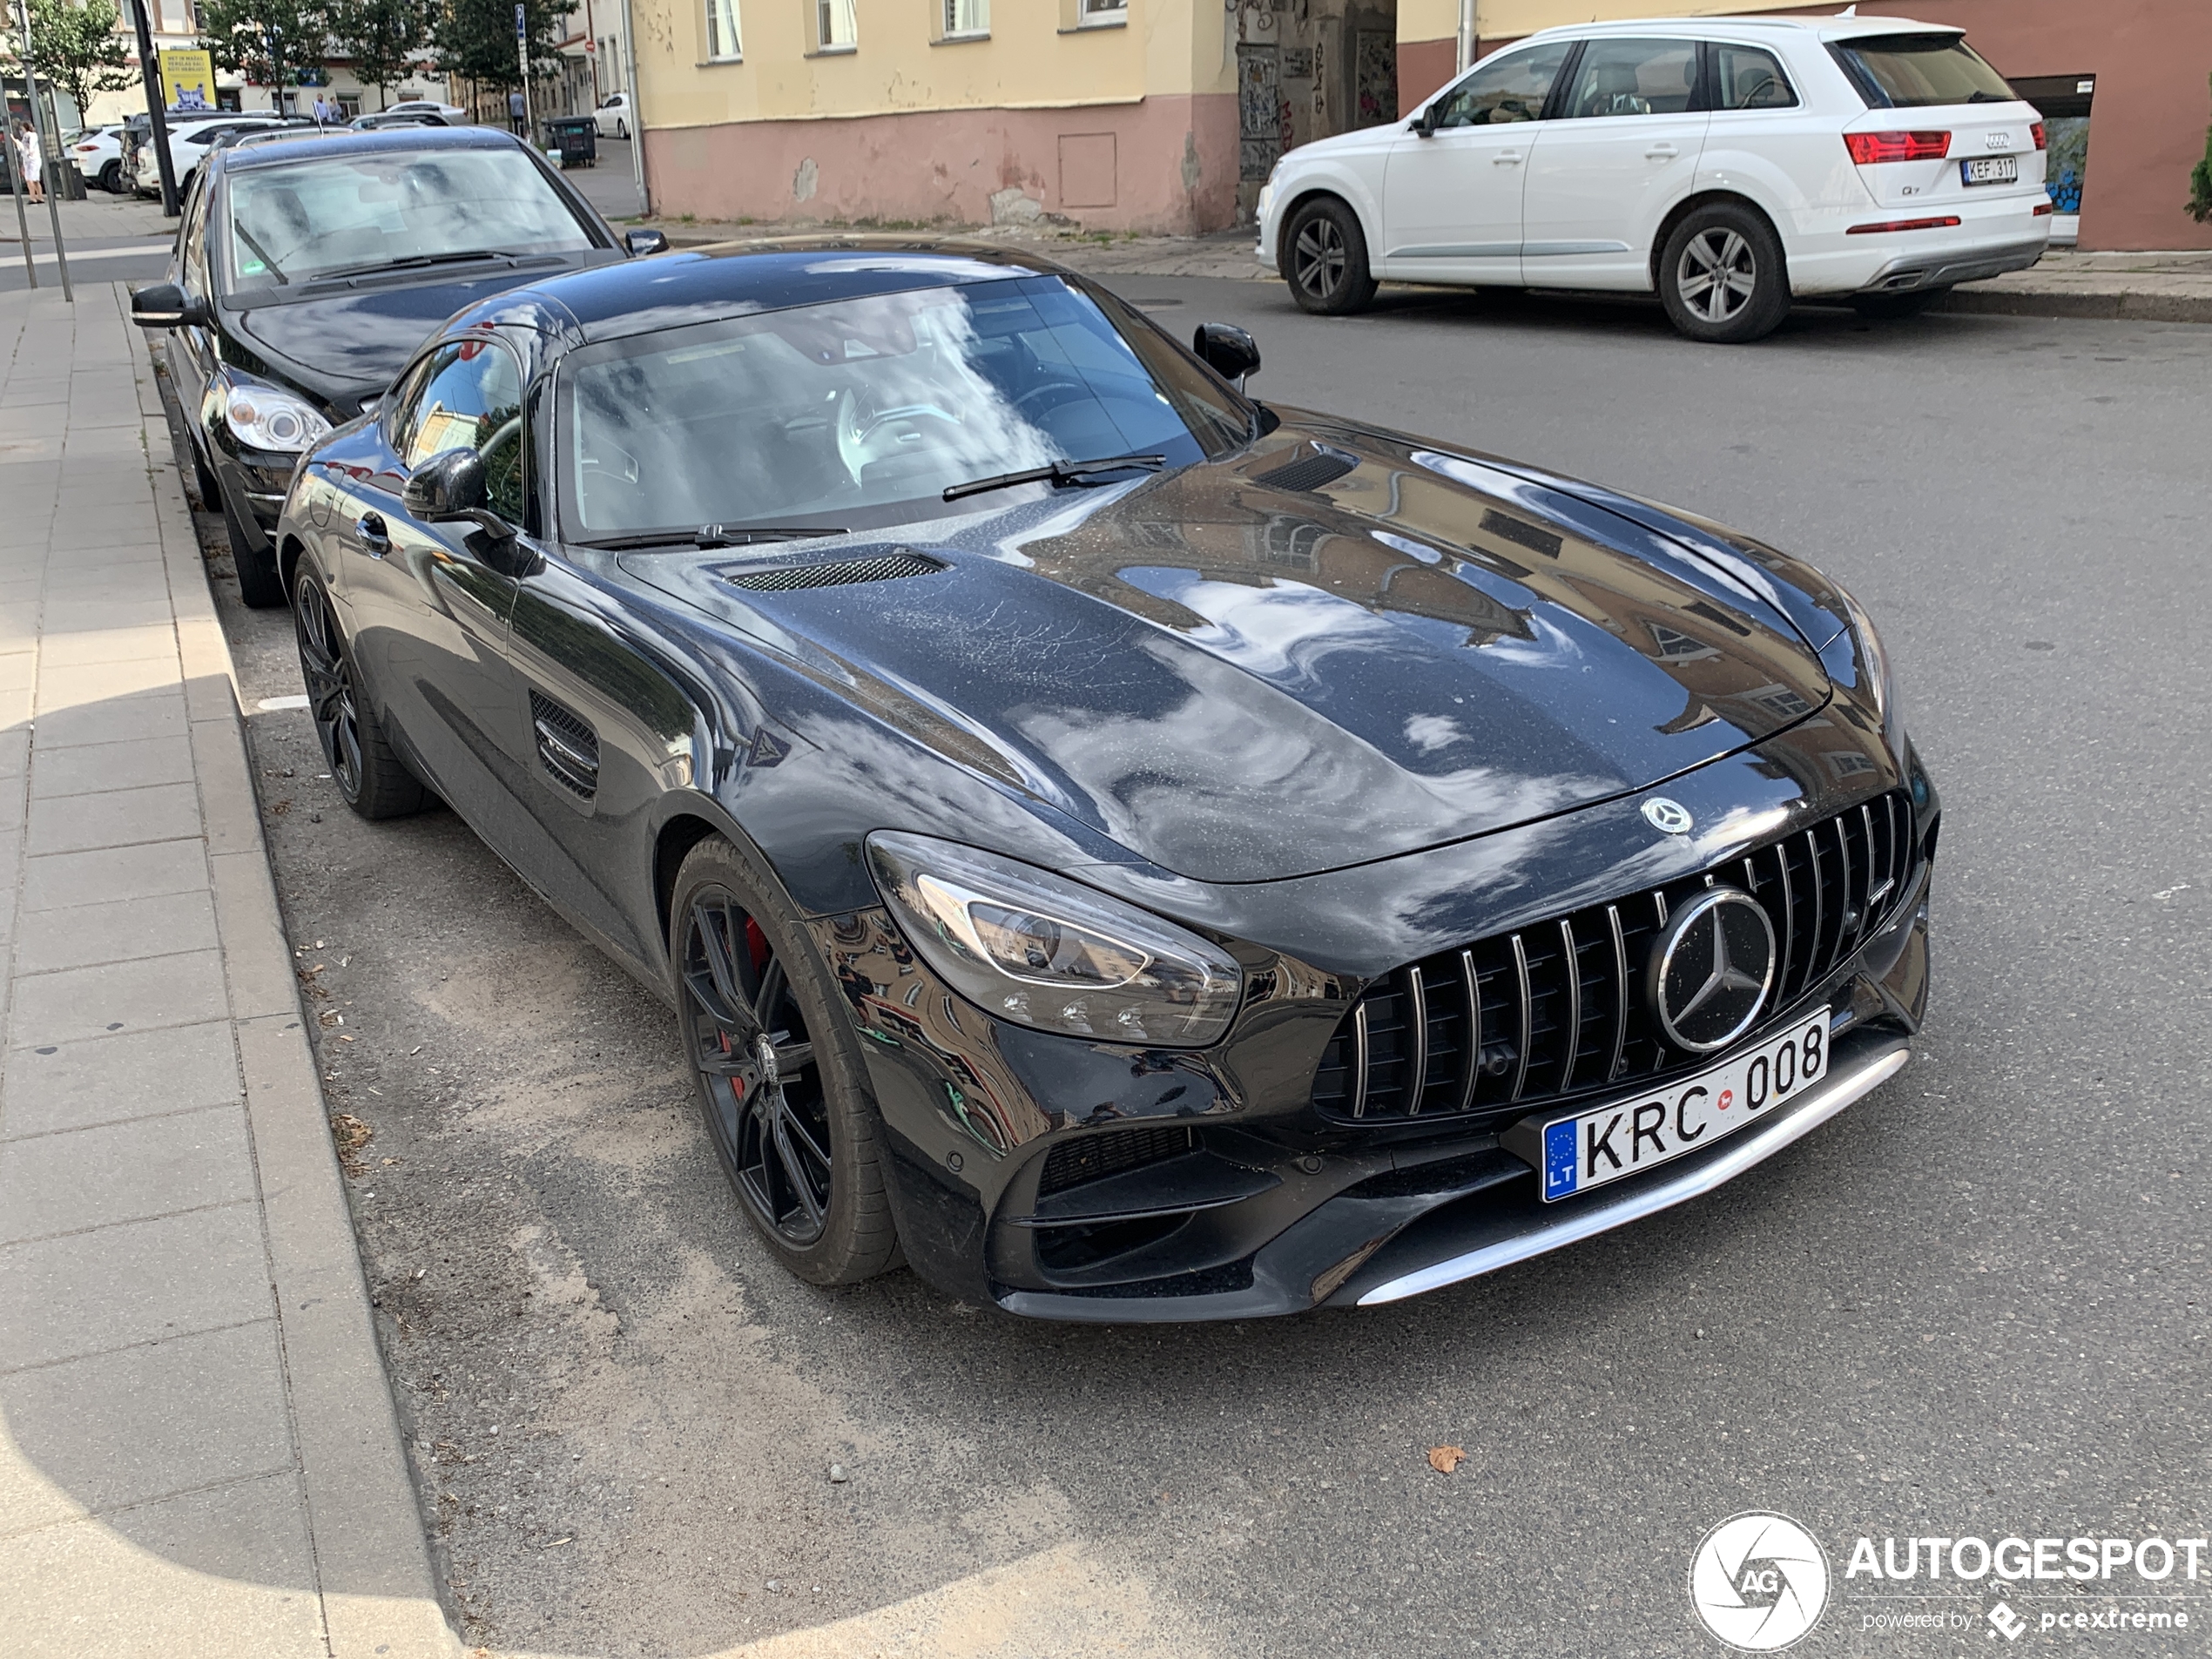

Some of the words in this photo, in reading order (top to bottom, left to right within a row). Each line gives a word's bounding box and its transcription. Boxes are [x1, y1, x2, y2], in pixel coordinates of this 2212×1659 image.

[1970, 161, 1990, 179] KEF
[1997, 159, 2013, 177] 317
[1588, 1086, 1708, 1178] KRC
[1747, 1024, 1822, 1109] 008
[1549, 1165, 1574, 1187] LT
